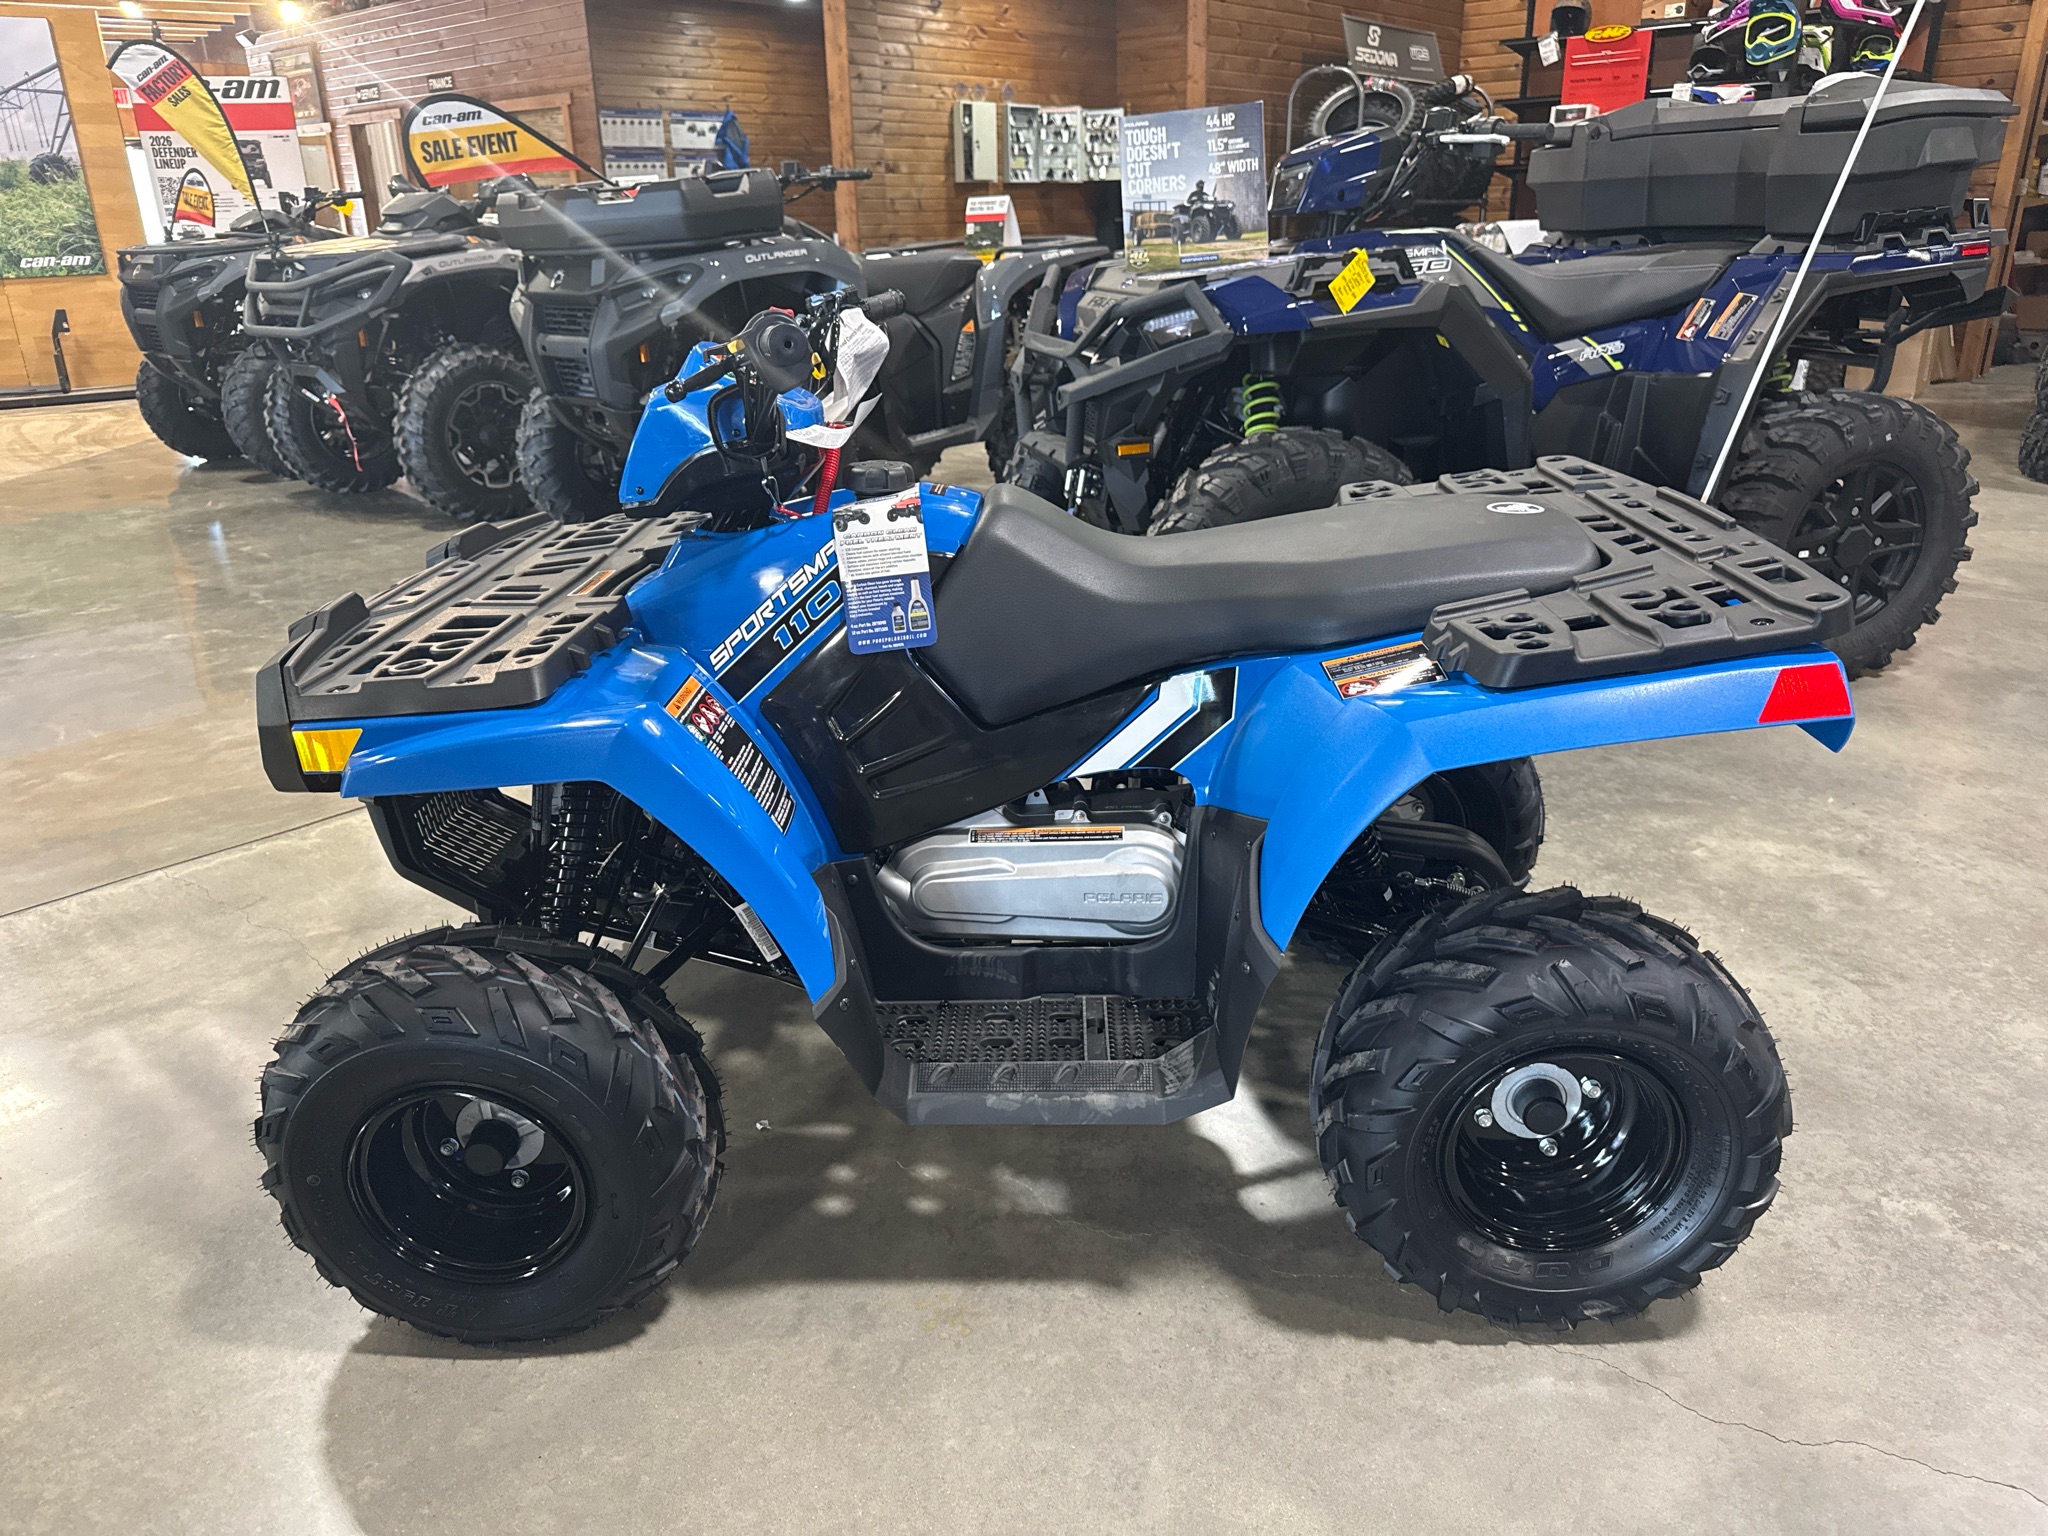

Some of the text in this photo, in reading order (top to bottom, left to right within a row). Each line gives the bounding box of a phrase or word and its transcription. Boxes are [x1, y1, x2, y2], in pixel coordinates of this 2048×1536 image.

[1354, 48, 1398, 68] SEDONA
[136, 55, 169, 82] can-am
[141, 62, 188, 102] FACTORY
[429, 76, 453, 89] FINANCE
[167, 86, 191, 107] SALES
[360, 87, 379, 99] SERVICE
[422, 110, 482, 126] can-am
[1206, 112, 1235, 128] 44 HP
[149, 136, 172, 146] 2026
[1125, 126, 1166, 146] TOUGH
[152, 147, 198, 158] DEFENDER
[420, 130, 518, 163] SALE EVENT
[1126, 142, 1180, 162] DOESN'T
[155, 159, 186, 169] LINEUP
[1127, 162, 1152, 178] CUT
[1227, 158, 1259, 173] WIDTH
[1128, 175, 1186, 195] CORNERS
[20, 256, 91, 268] can-am
[438, 254, 495, 269] OUTLANDER
[745, 248, 808, 264] OUTLANDER
[843, 530, 884, 539] CARBON
[865, 533, 922, 543] TREATMENT
[773, 579, 841, 651] 110
[678, 688, 692, 705] WARNING
[1083, 892, 1163, 904] POLARIS
[1661, 1222, 1684, 1242] MANUAL
